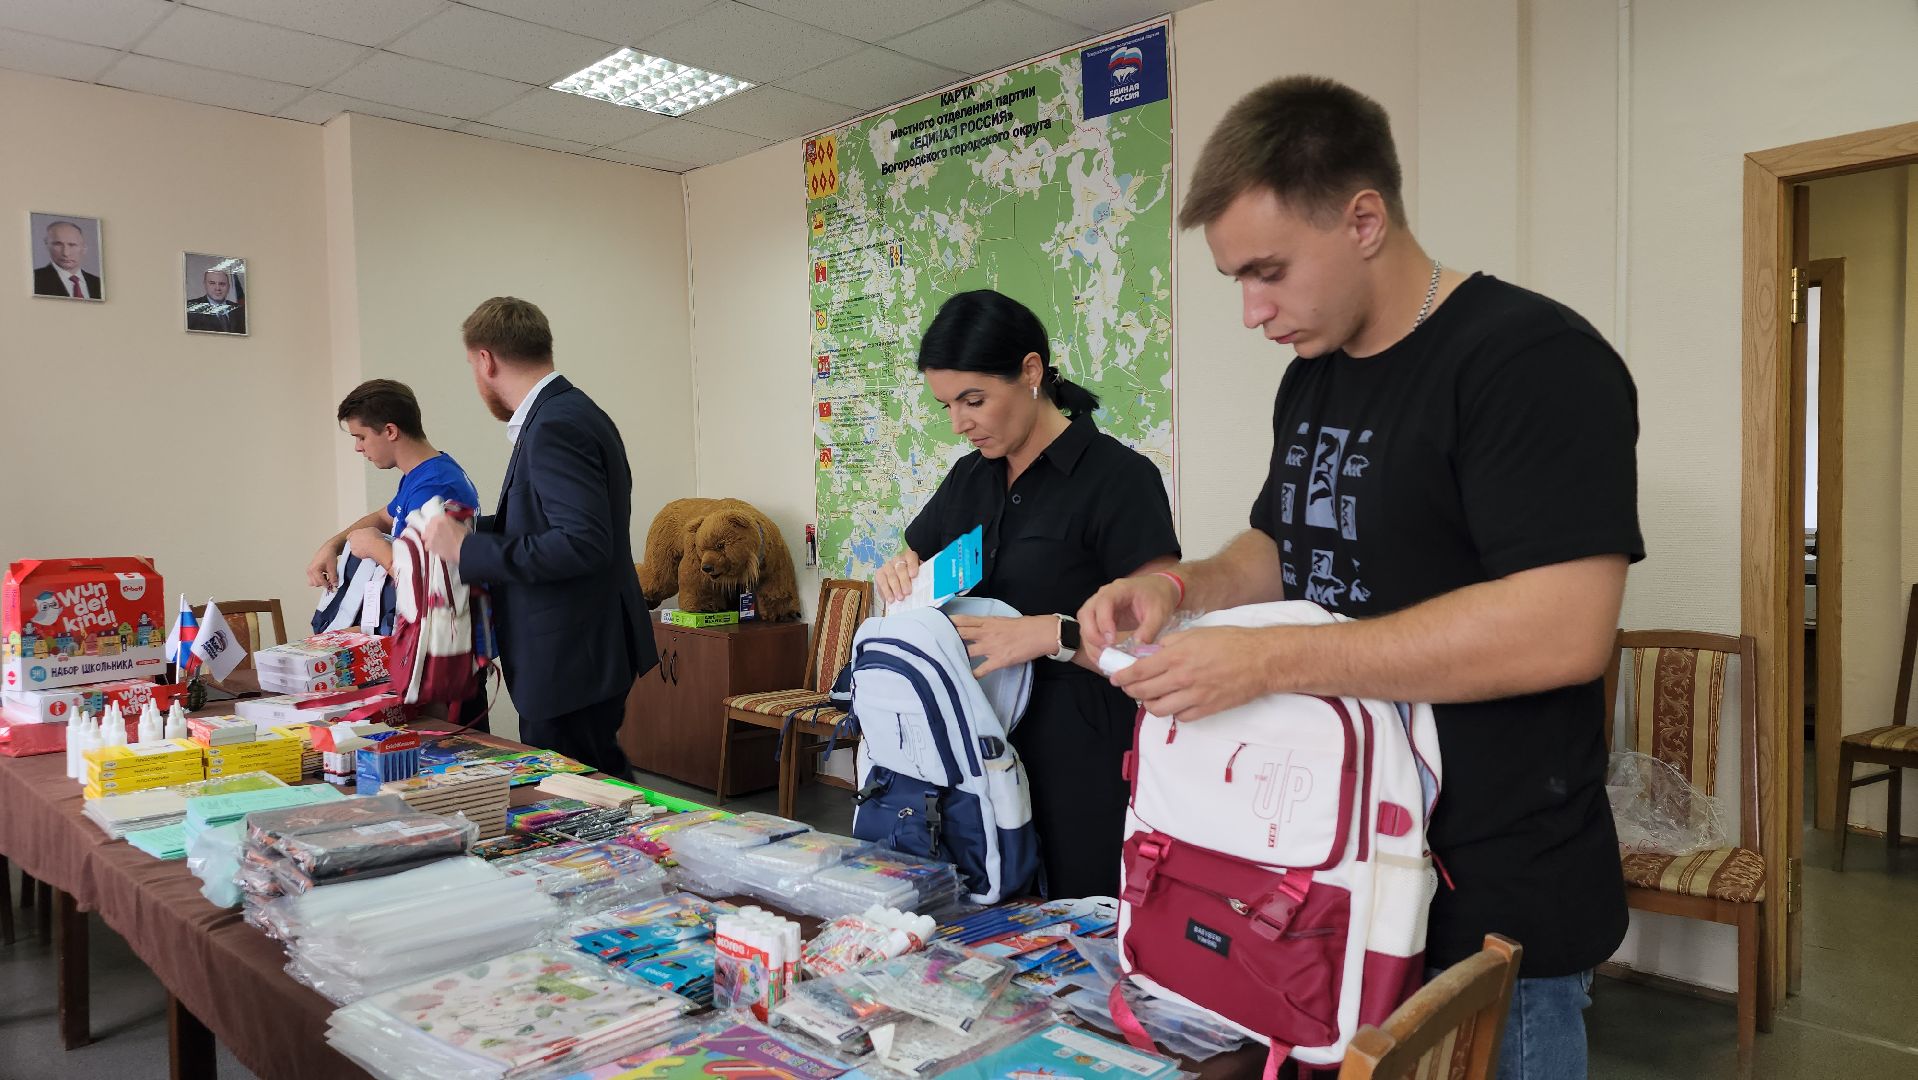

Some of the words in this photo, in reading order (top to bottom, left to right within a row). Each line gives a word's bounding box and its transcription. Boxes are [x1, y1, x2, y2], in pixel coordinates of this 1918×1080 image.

[940, 86, 975, 107] КАРТА
[1109, 82, 1140, 98] ЕДИНАЯ
[1109, 91, 1140, 106] РОССИЯ
[890, 117, 935, 140] местного
[937, 99, 993, 125] отделения
[995, 86, 1036, 108] партии
[910, 125, 958, 150] «ЕДИНАЯ
[960, 110, 1014, 135] РОССИЯ»
[881, 147, 948, 176] Богородского
[949, 130, 1010, 157] городского
[1012, 118, 1052, 138] округа
[51, 666, 79, 678] НАБОР
[81, 659, 134, 675] ШКОЛЬНИКА
